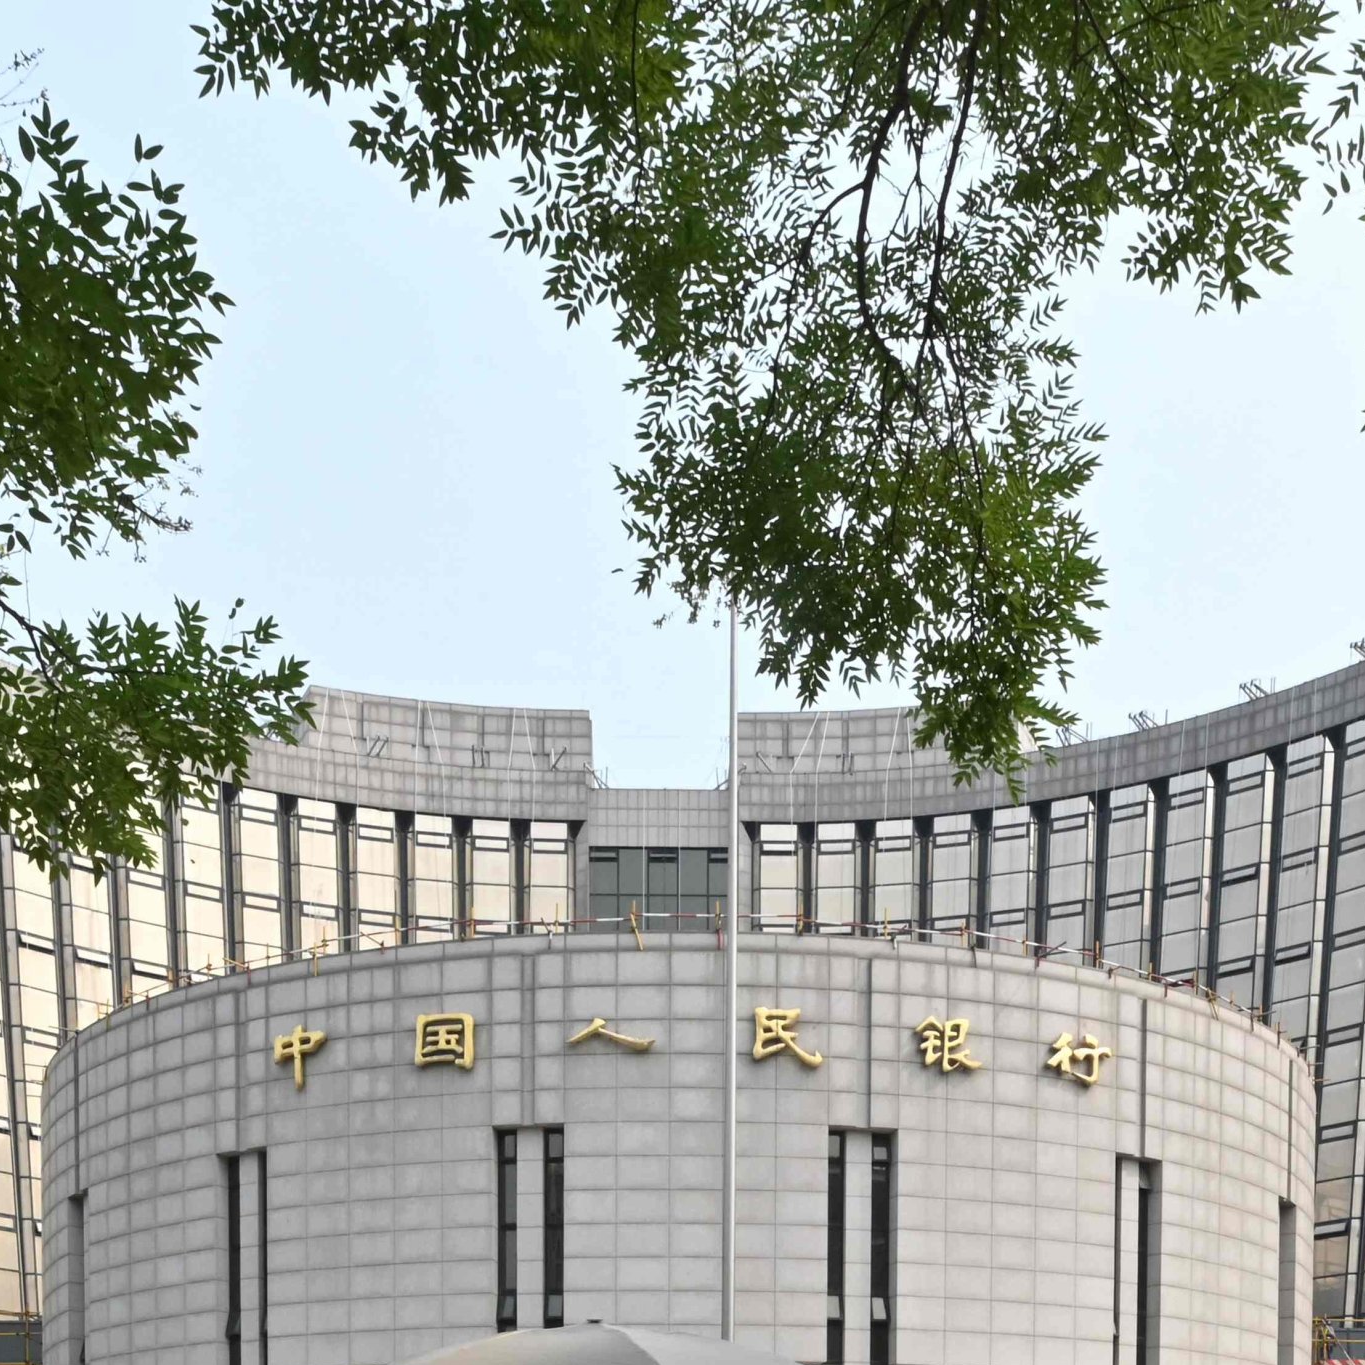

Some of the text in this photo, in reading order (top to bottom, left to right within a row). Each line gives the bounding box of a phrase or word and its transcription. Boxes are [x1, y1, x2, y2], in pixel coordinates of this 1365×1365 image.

[273, 1007, 1112, 1092] 中国人民银行
